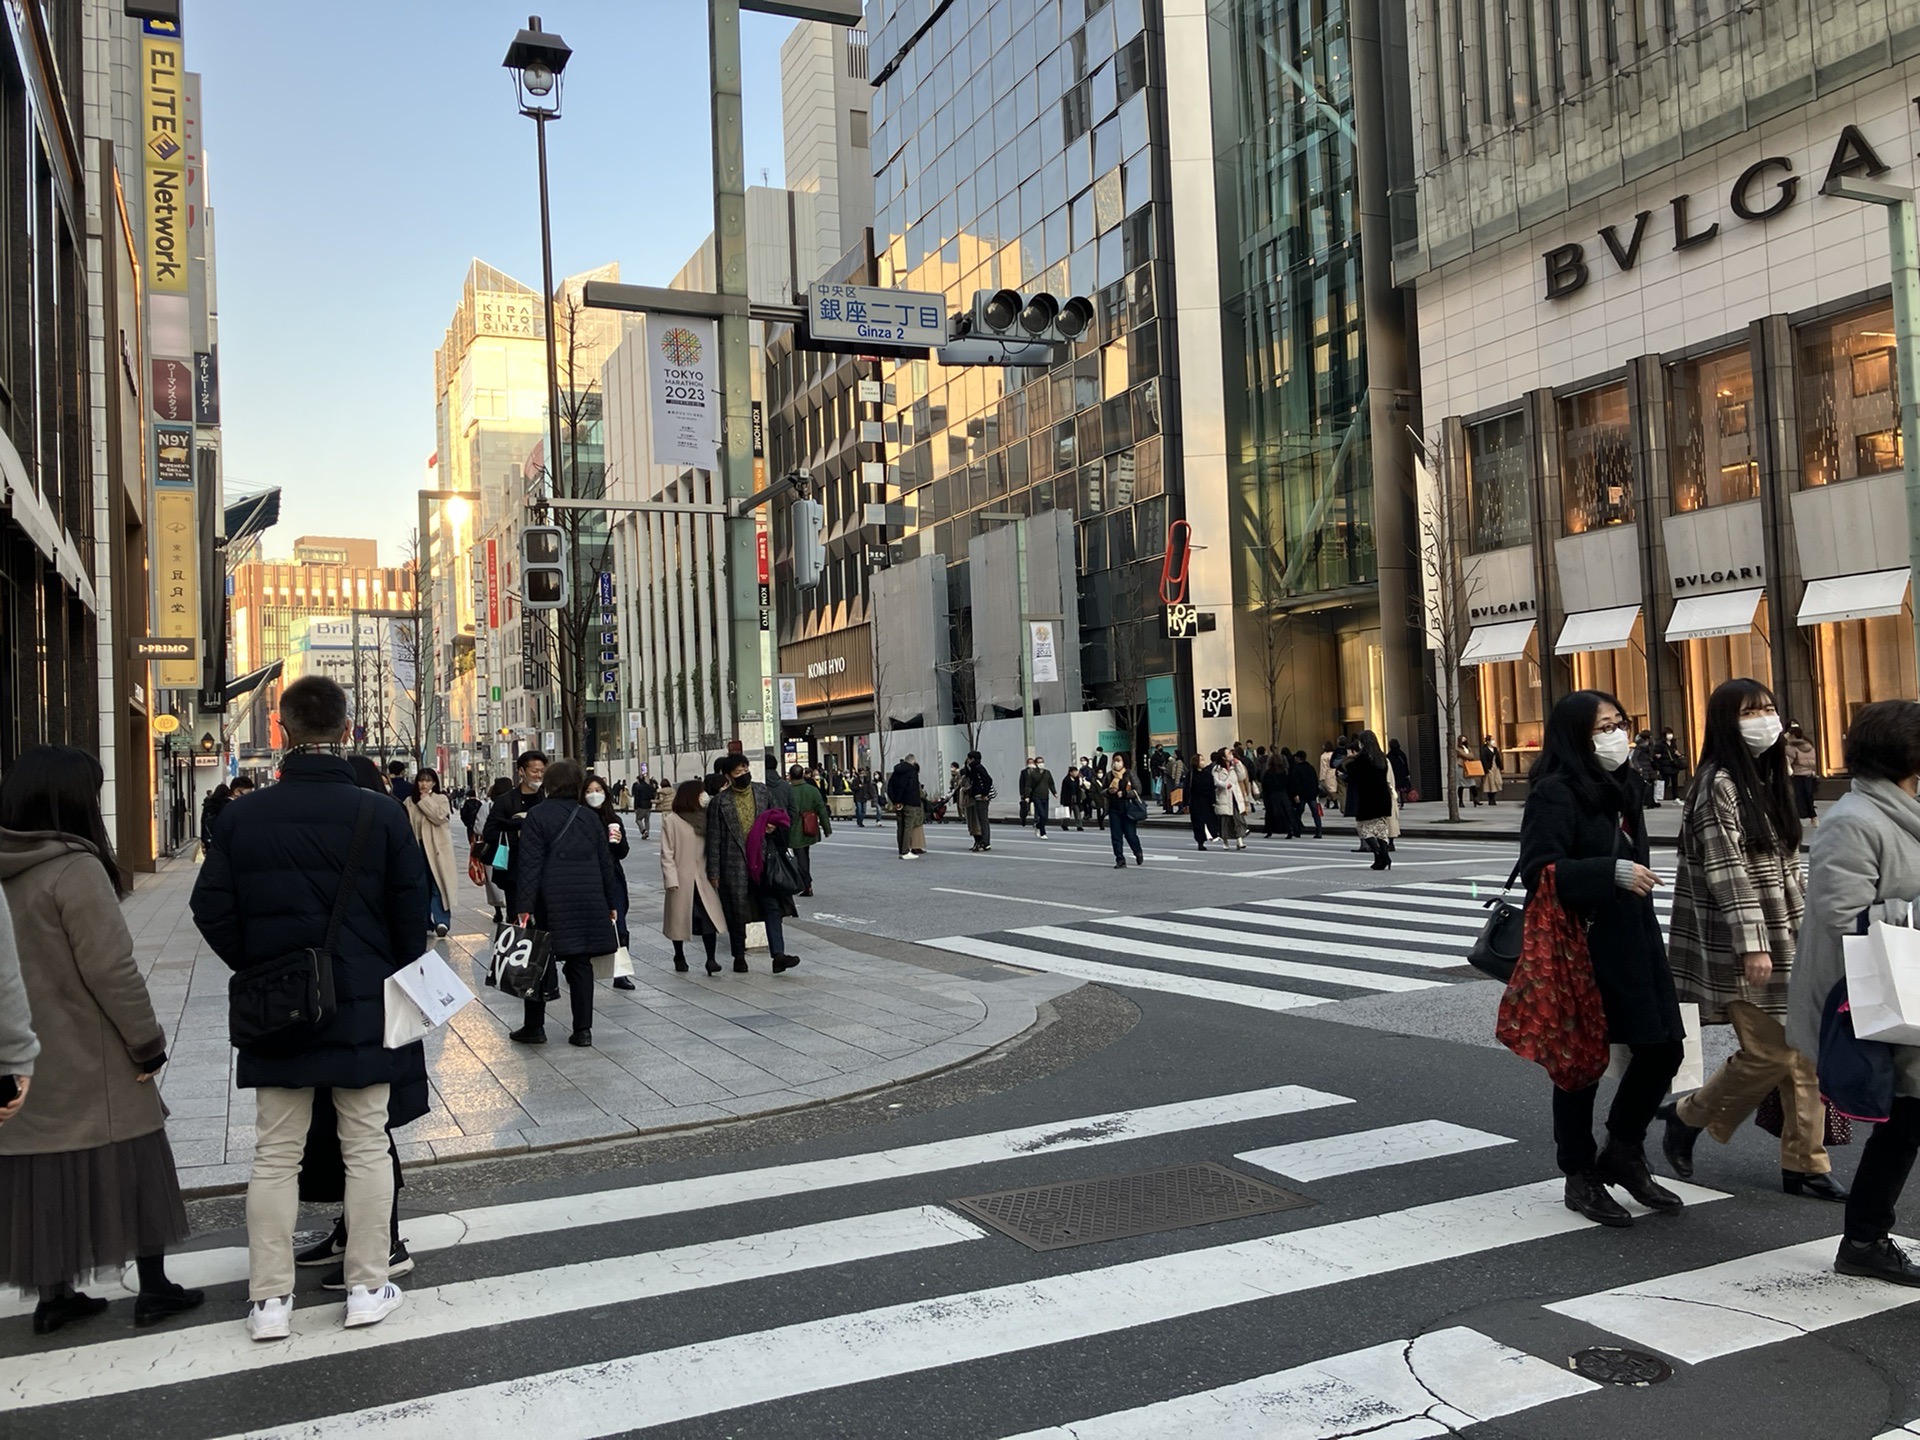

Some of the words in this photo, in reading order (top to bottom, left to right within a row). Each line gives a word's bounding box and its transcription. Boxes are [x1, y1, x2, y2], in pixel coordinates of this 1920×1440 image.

[150, 48, 177, 134] ELITE
[1542, 96, 1920, 301] BVLGA
[817, 284, 857, 298] 中央区
[819, 298, 939, 329] 銀座二丁目
[857, 324, 892, 339] Ginza
[896, 328, 905, 340] 2
[664, 368, 704, 381] TOKYO
[167, 362, 178, 419] ウーマンスタッフ
[664, 379, 704, 388] MARATHON
[665, 385, 705, 401] 2023
[158, 434, 189, 447] N9Y
[1674, 565, 1762, 589] BVLGARI
[760, 587, 769, 627] KOMHYO
[1471, 600, 1535, 618] BVLGARI
[317, 622, 375, 635] Brilia
[1688, 629, 1728, 638] BVLGARI
[138, 644, 189, 654] I-PRIMO
